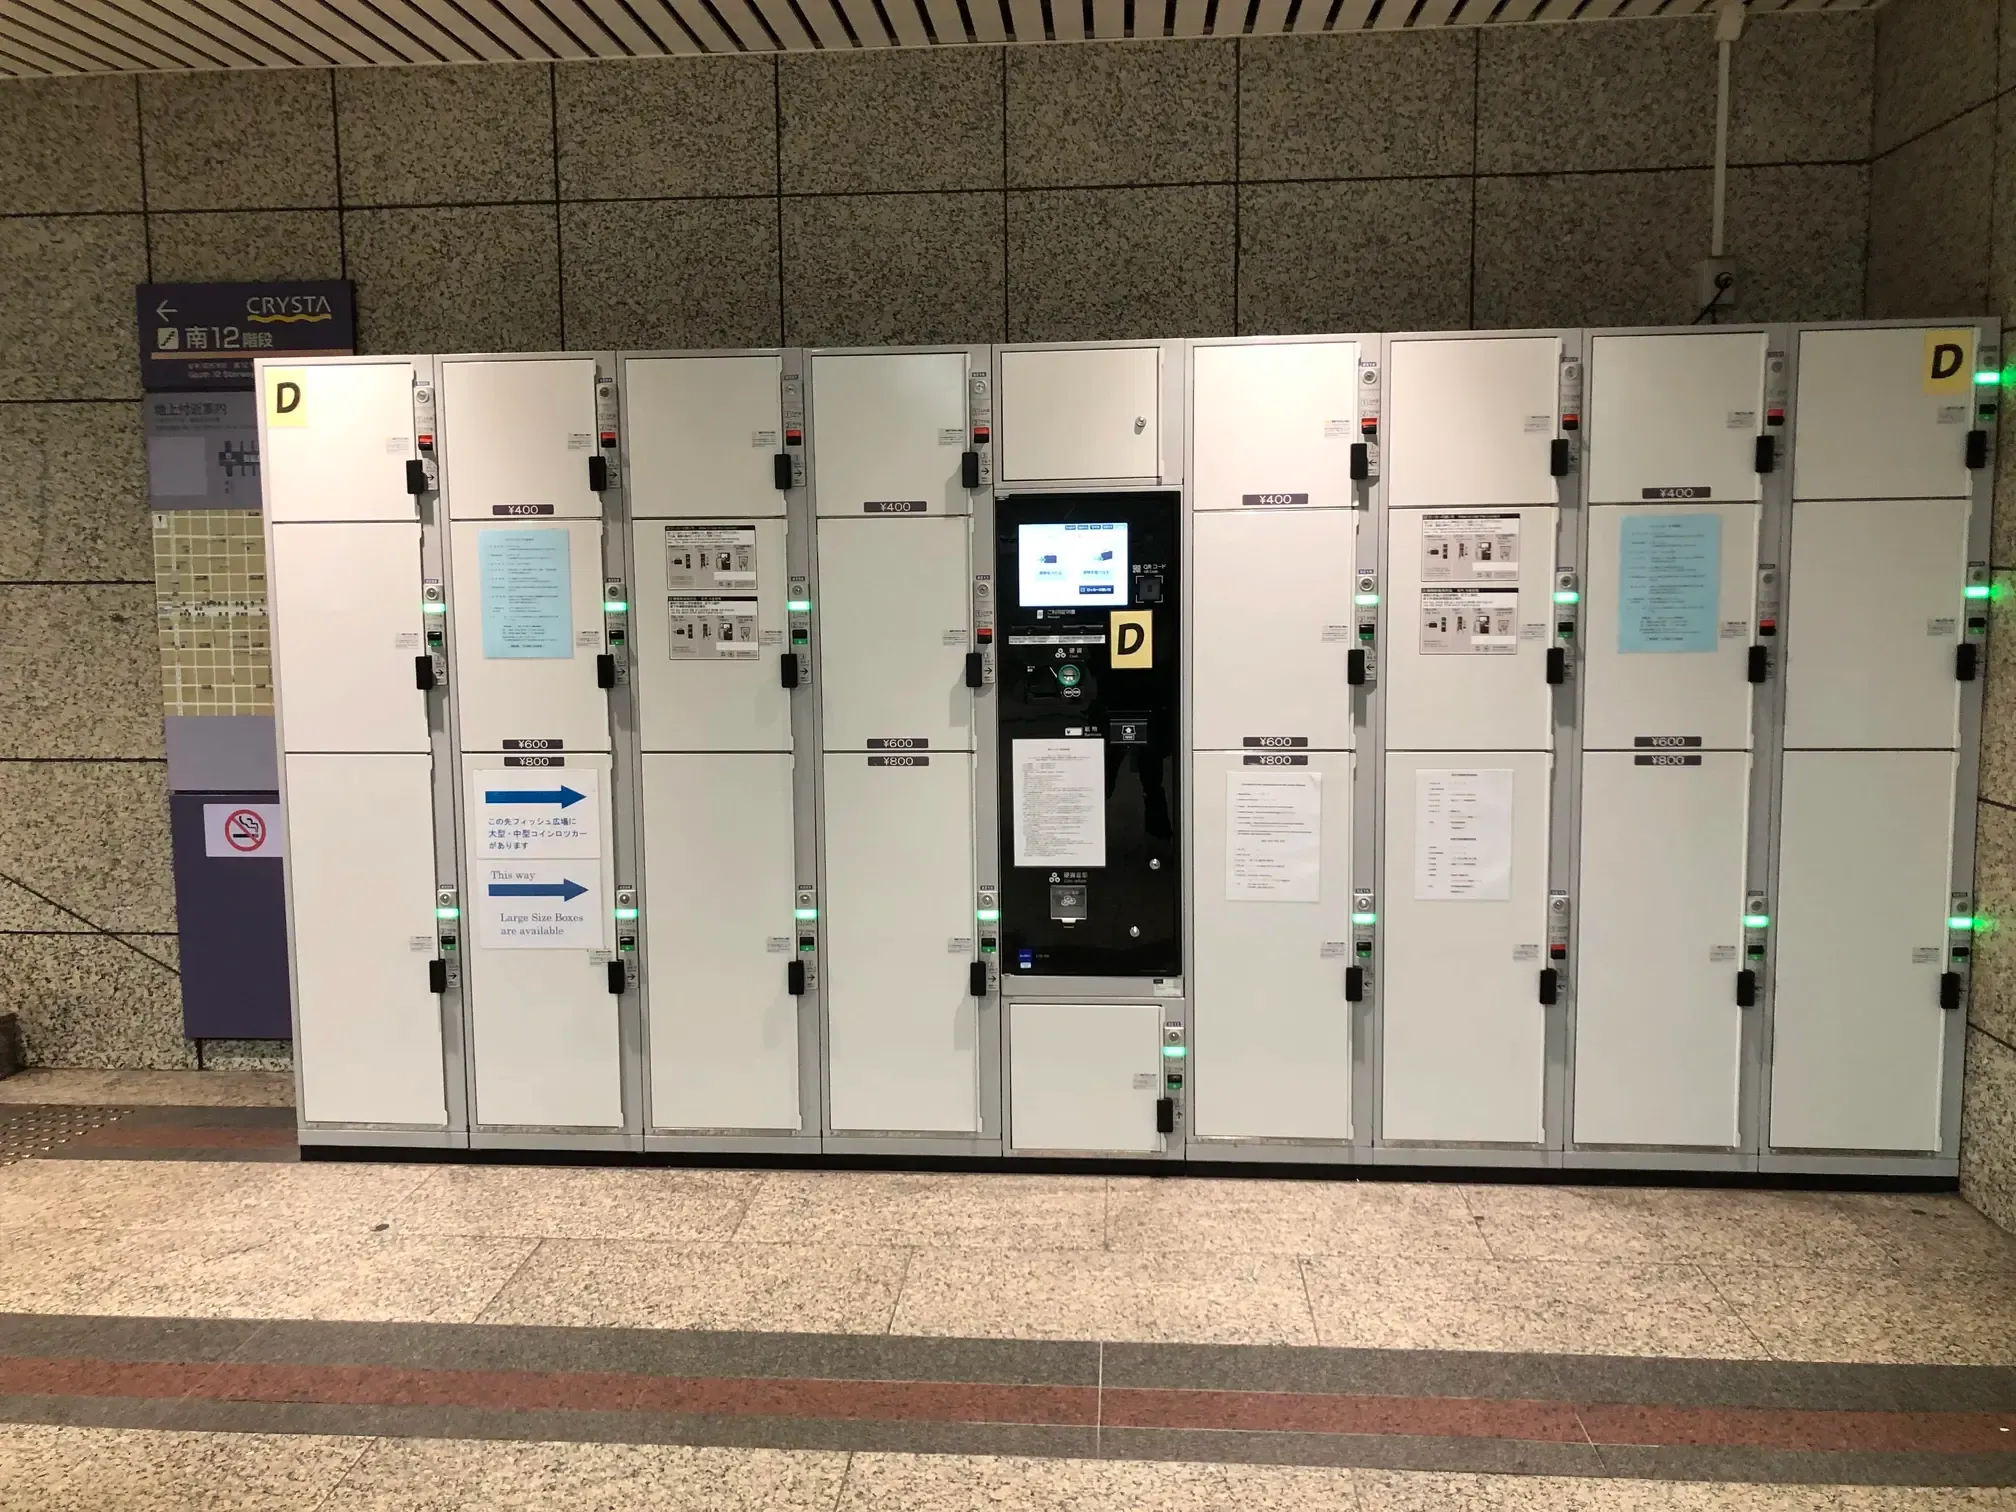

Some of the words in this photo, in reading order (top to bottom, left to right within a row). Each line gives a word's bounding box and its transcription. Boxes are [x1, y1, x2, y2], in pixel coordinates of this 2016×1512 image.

[246, 296, 332, 315] CRYSTA
[1931, 343, 1963, 379] D
[276, 382, 301, 413] D
[1659, 487, 1693, 498] ¥400
[1259, 494, 1292, 504] ¥400
[508, 505, 539, 515] ¥400
[880, 502, 911, 512] ¥400
[1117, 623, 1145, 655] D
[518, 740, 549, 749] ¥600
[883, 738, 914, 748] ¥600
[1260, 737, 1292, 747] ¥600
[1651, 736, 1685, 747] ¥600
[519, 757, 549, 766] ¥800
[883, 757, 914, 766] ¥800
[1260, 756, 1292, 765] ¥800
[1651, 754, 1685, 765] ¥800
[488, 817, 577, 826] この先フィッシュ広場に
[488, 841, 529, 850] があります
[490, 870, 513, 880] This
[515, 872, 536, 882] way
[500, 912, 529, 924] Large
[531, 912, 553, 923] Size
[555, 912, 584, 923] Boxes
[500, 928, 517, 936] are
[519, 926, 565, 936] available
